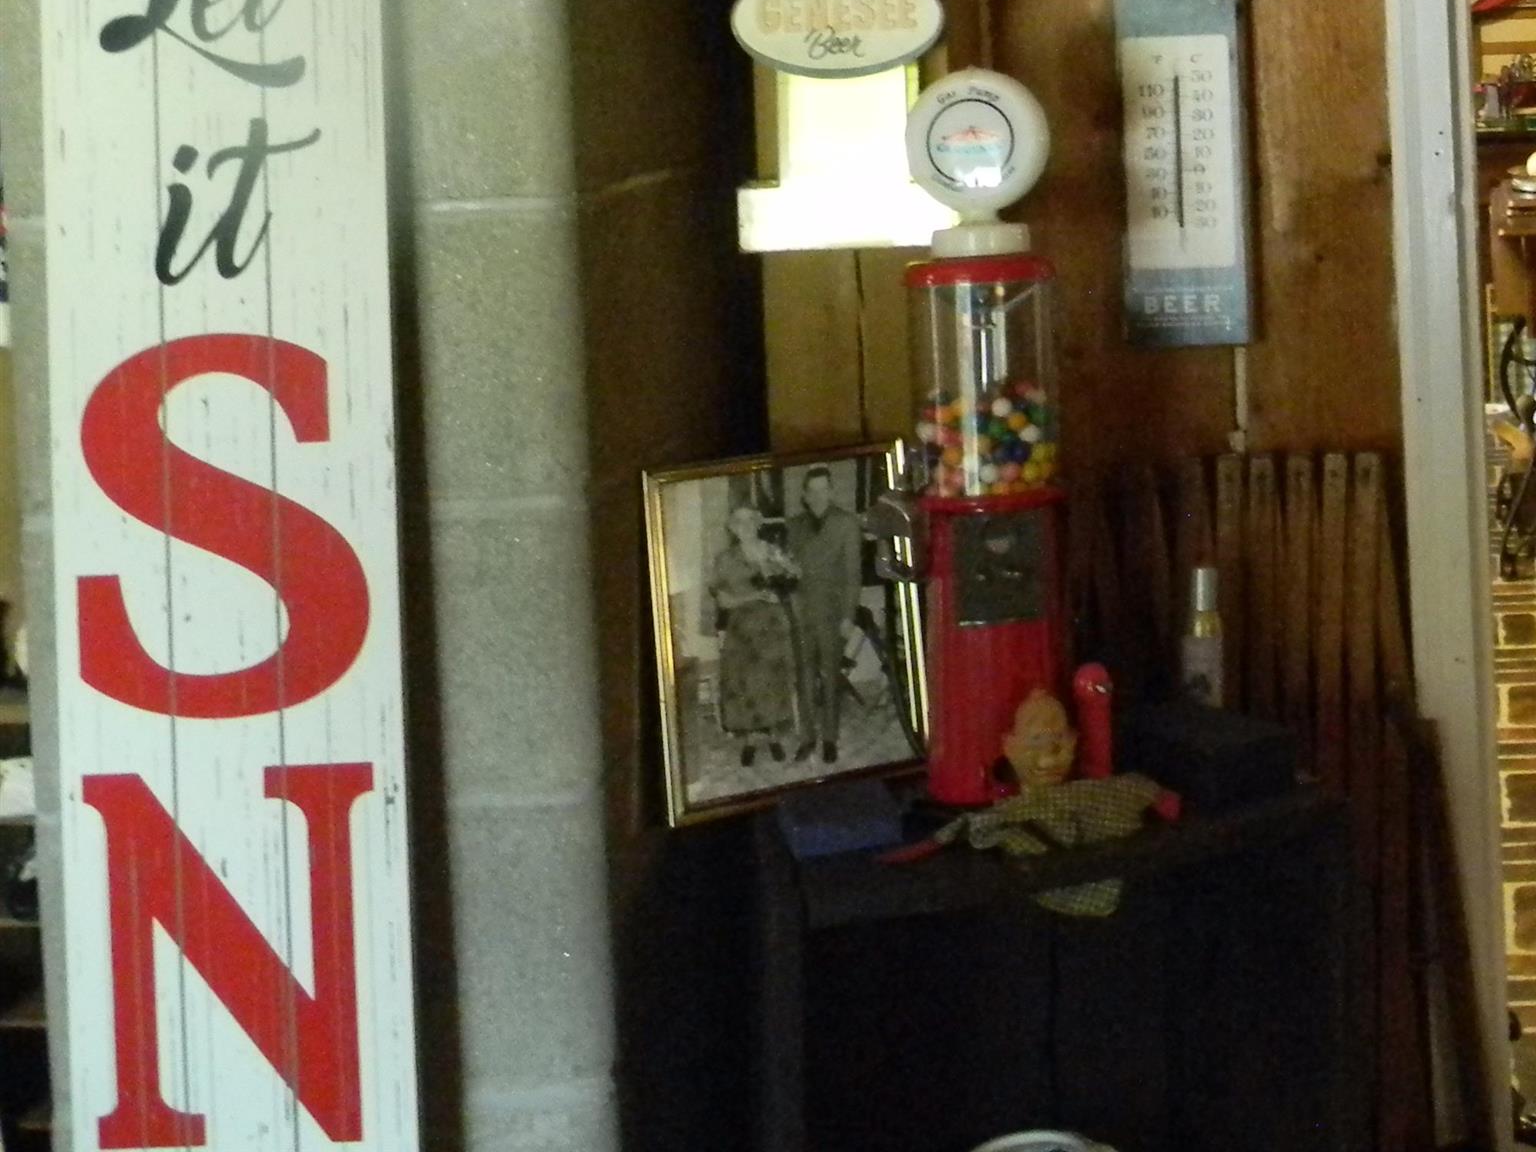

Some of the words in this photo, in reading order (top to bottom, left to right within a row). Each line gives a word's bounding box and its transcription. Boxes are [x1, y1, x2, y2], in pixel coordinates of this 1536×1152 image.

[804, 24, 867, 60] Beer
[155, 116, 323, 286] it
[1144, 294, 1222, 315] BEER
